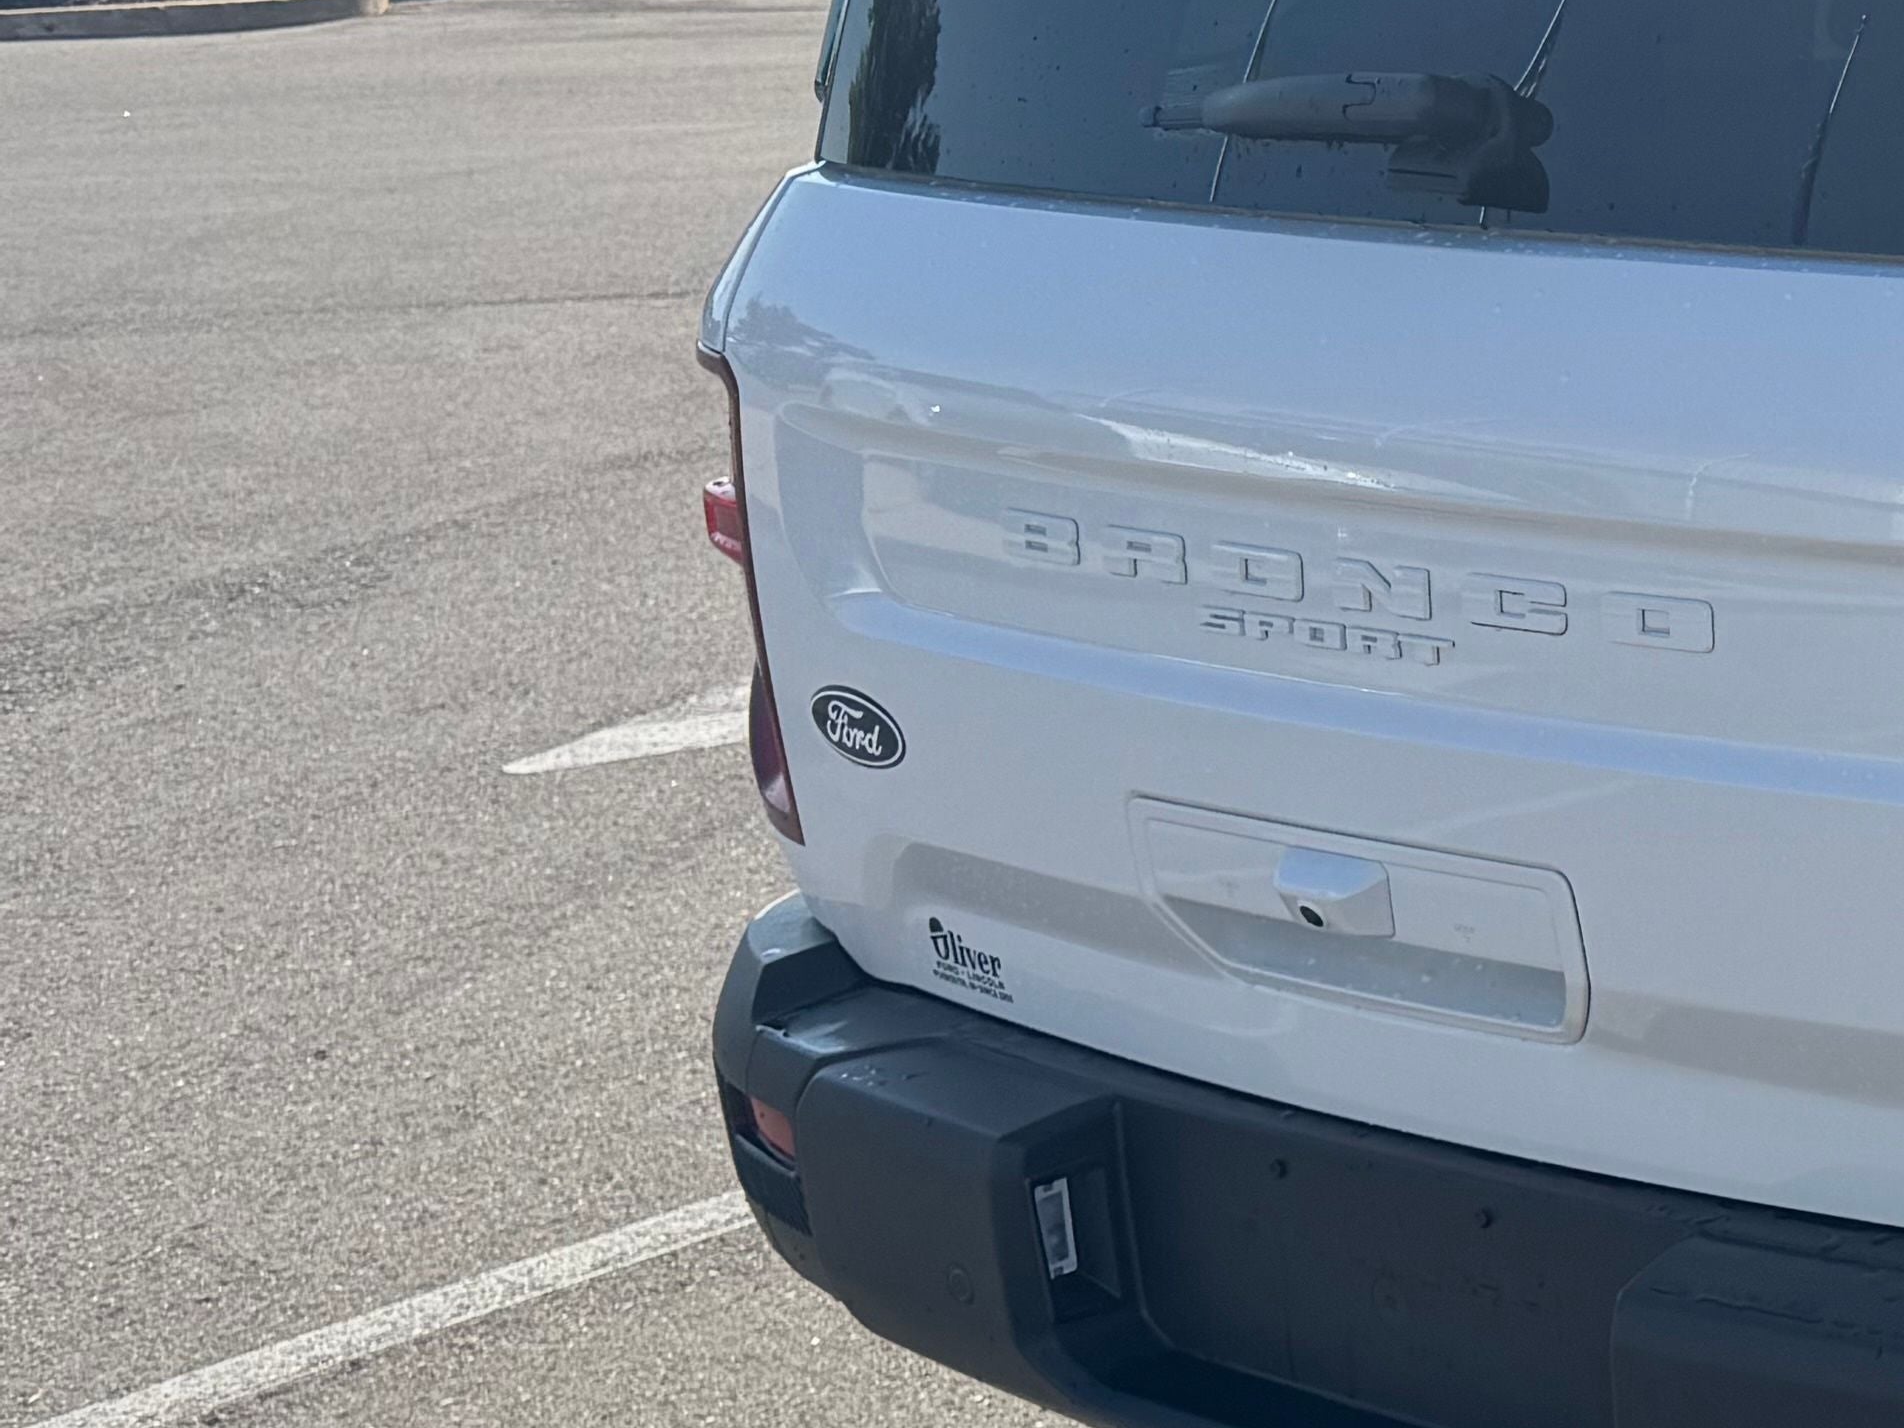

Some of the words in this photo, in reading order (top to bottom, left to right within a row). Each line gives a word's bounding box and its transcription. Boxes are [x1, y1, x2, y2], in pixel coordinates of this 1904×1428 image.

[1004, 506, 1716, 656] BRONCO
[1202, 606, 1456, 667] SPORT
[826, 699, 883, 756] Ford
[929, 917, 1003, 979] Oliver
